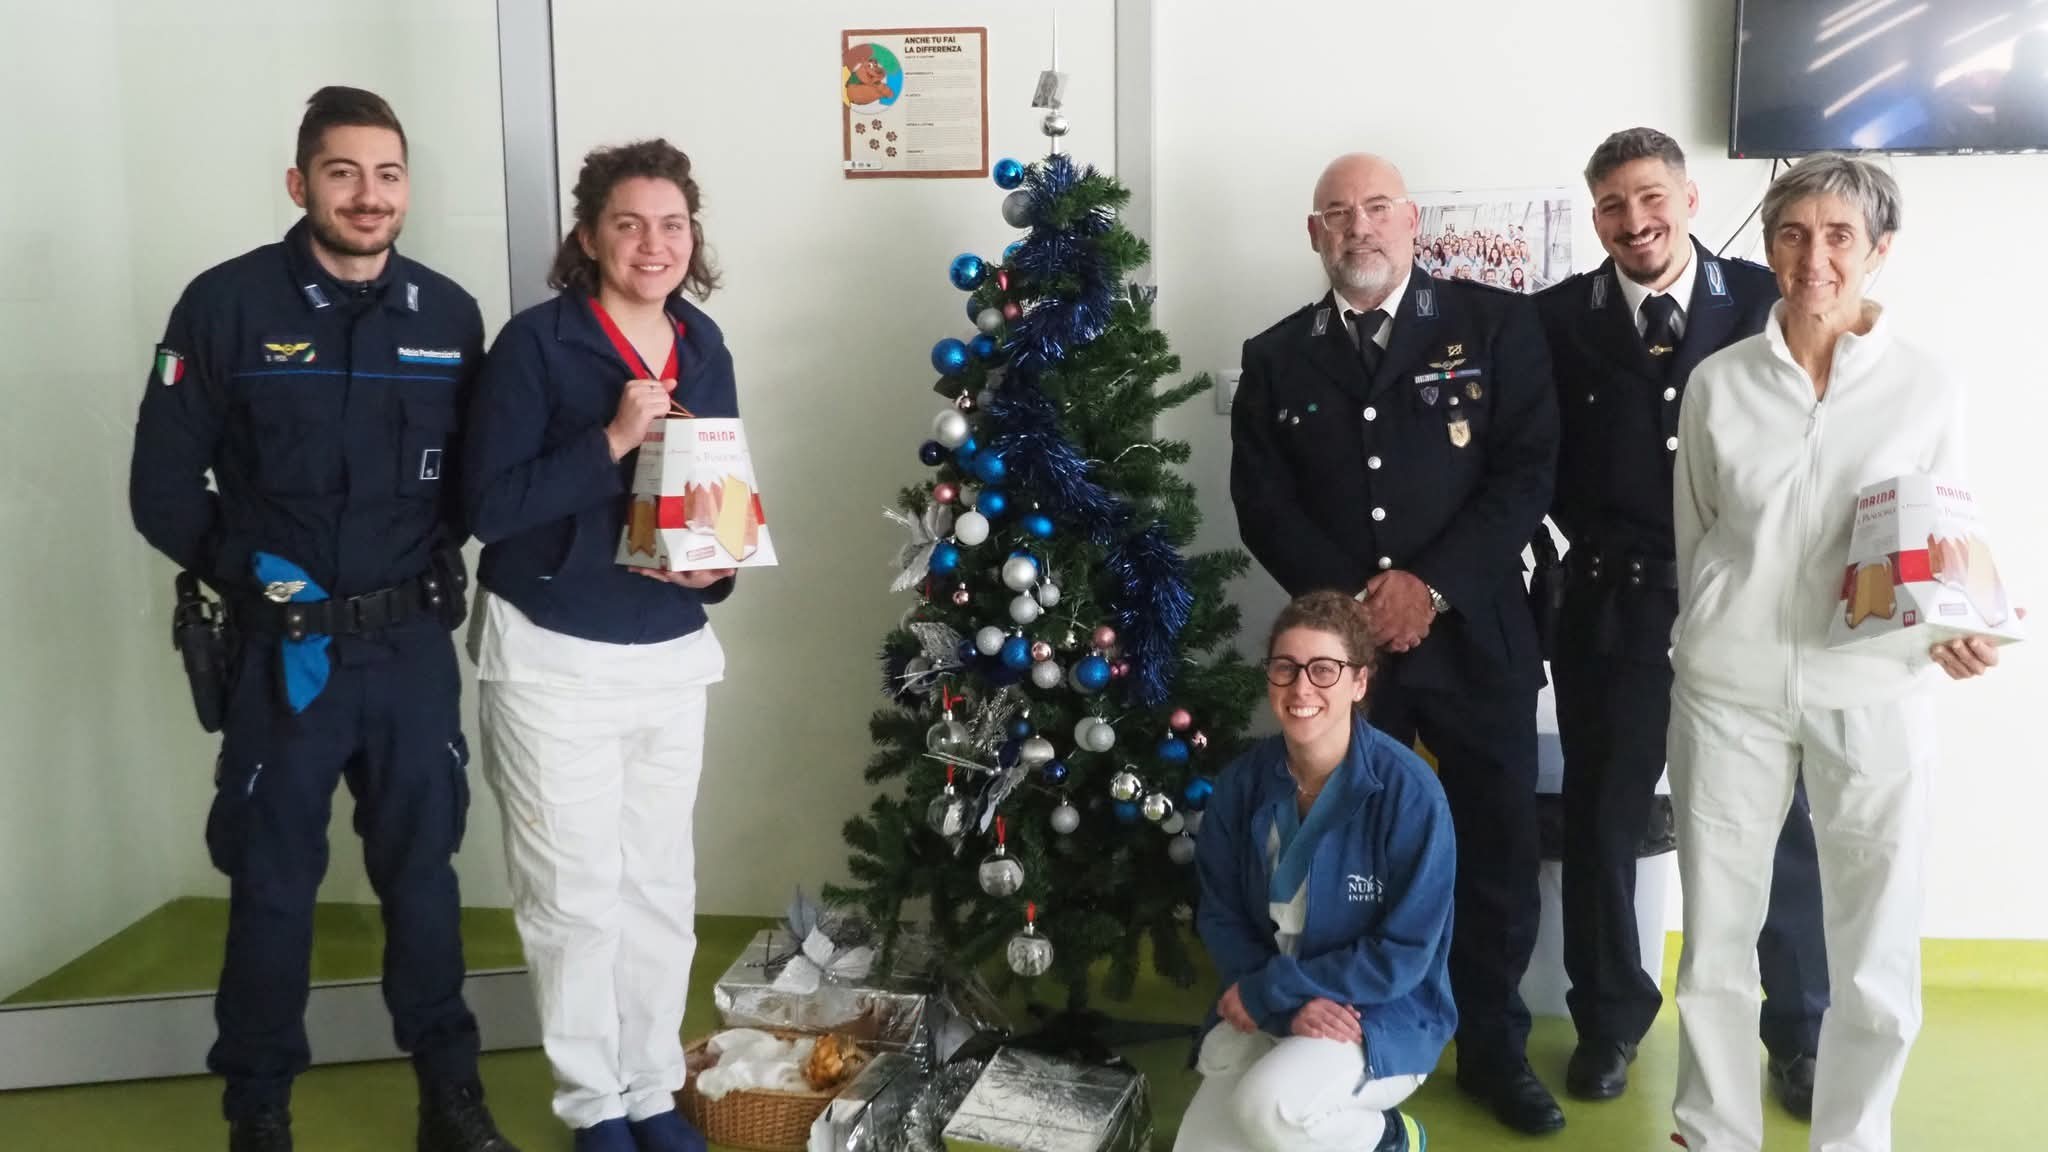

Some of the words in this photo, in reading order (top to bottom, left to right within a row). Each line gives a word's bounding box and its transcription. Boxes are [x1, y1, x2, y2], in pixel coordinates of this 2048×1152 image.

[904, 36, 929, 44] ANCHE
[916, 45, 962, 53] DIFFERENZA
[698, 431, 736, 441] MAINA
[1936, 486, 1973, 502] MAINA
[1858, 489, 1896, 510] MAINA
